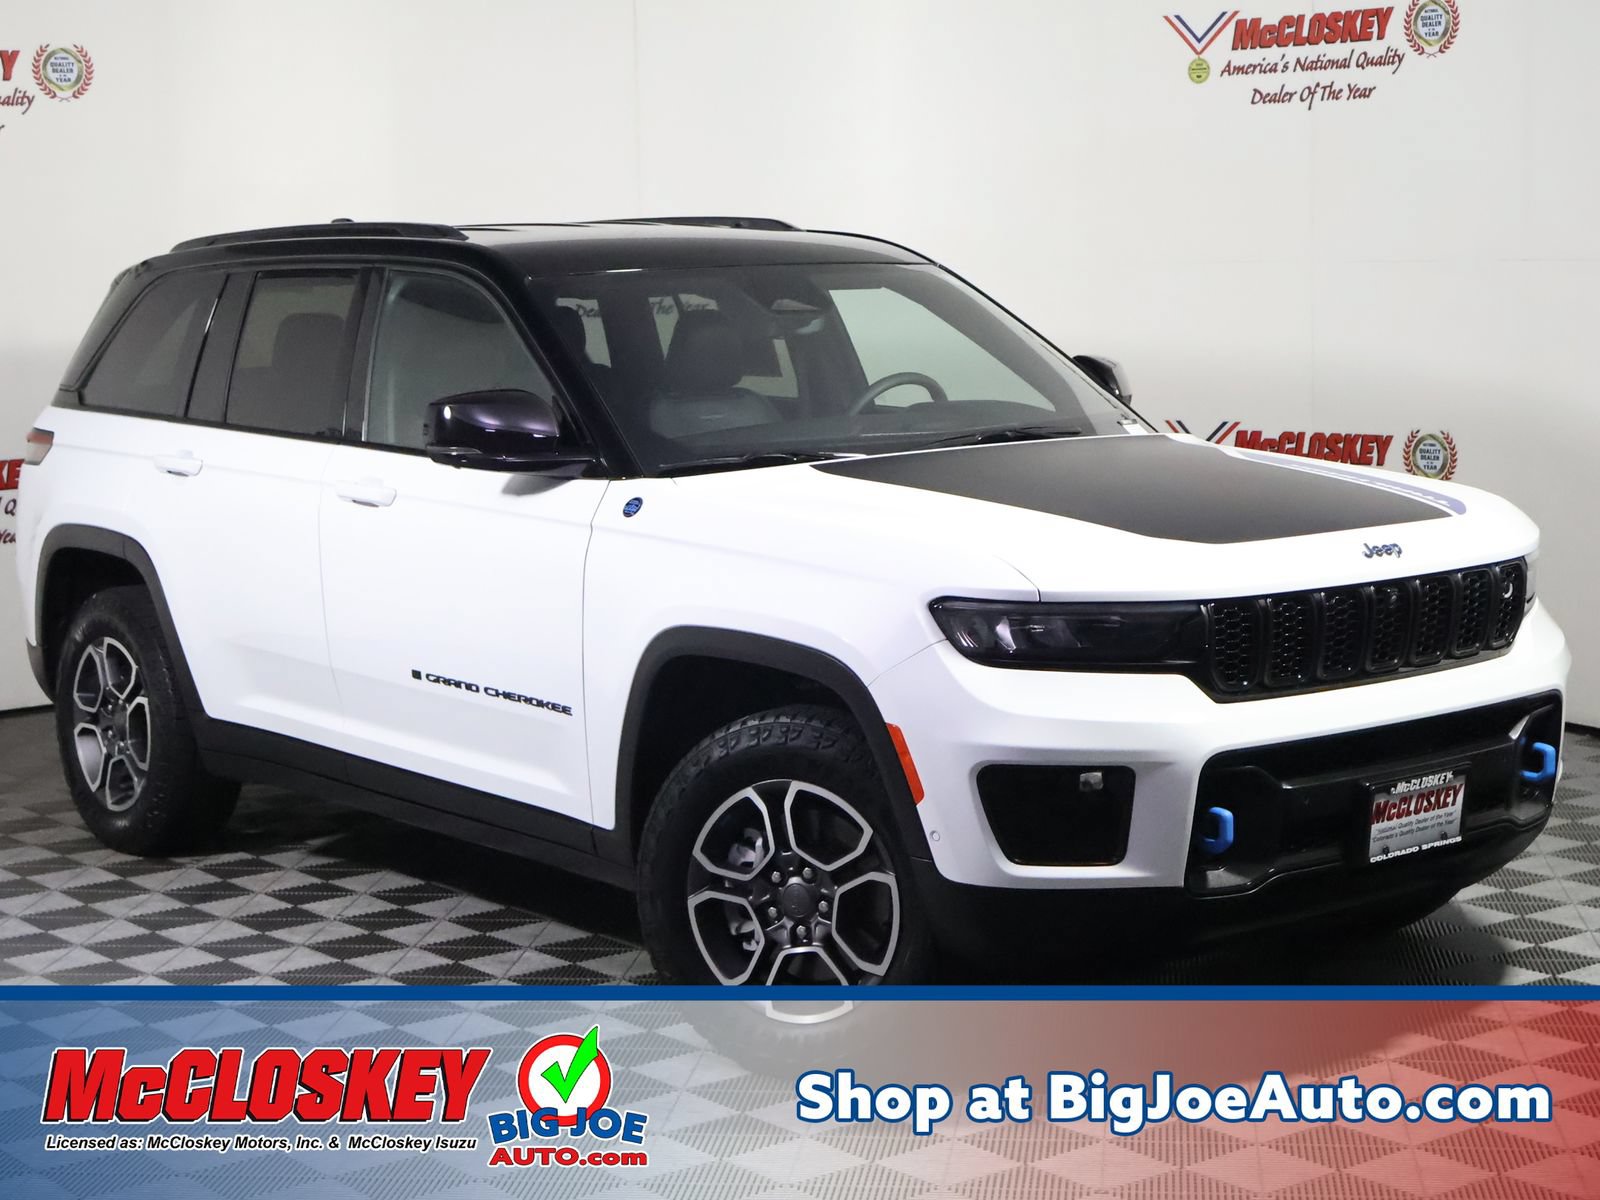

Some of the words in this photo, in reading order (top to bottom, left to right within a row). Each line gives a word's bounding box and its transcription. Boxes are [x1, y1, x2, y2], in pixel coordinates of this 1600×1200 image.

[1231, 6, 1394, 50] McCLOSKEY
[1220, 54, 1289, 77] America's
[1293, 49, 1355, 73] National
[1355, 46, 1405, 74] Quality
[1251, 84, 1297, 105] Dealer
[1300, 82, 1320, 110] Of
[1320, 81, 1344, 101] The
[1347, 83, 1376, 101] Year
[1362, 543, 1402, 558] Jeep
[425, 673, 480, 693] GRAND
[484, 686, 573, 716] CHEROKEE
[1370, 784, 1464, 825] McCLOSKEY
[1370, 846, 1420, 863] COLORADO
[1421, 836, 1462, 851] SPRINGS
